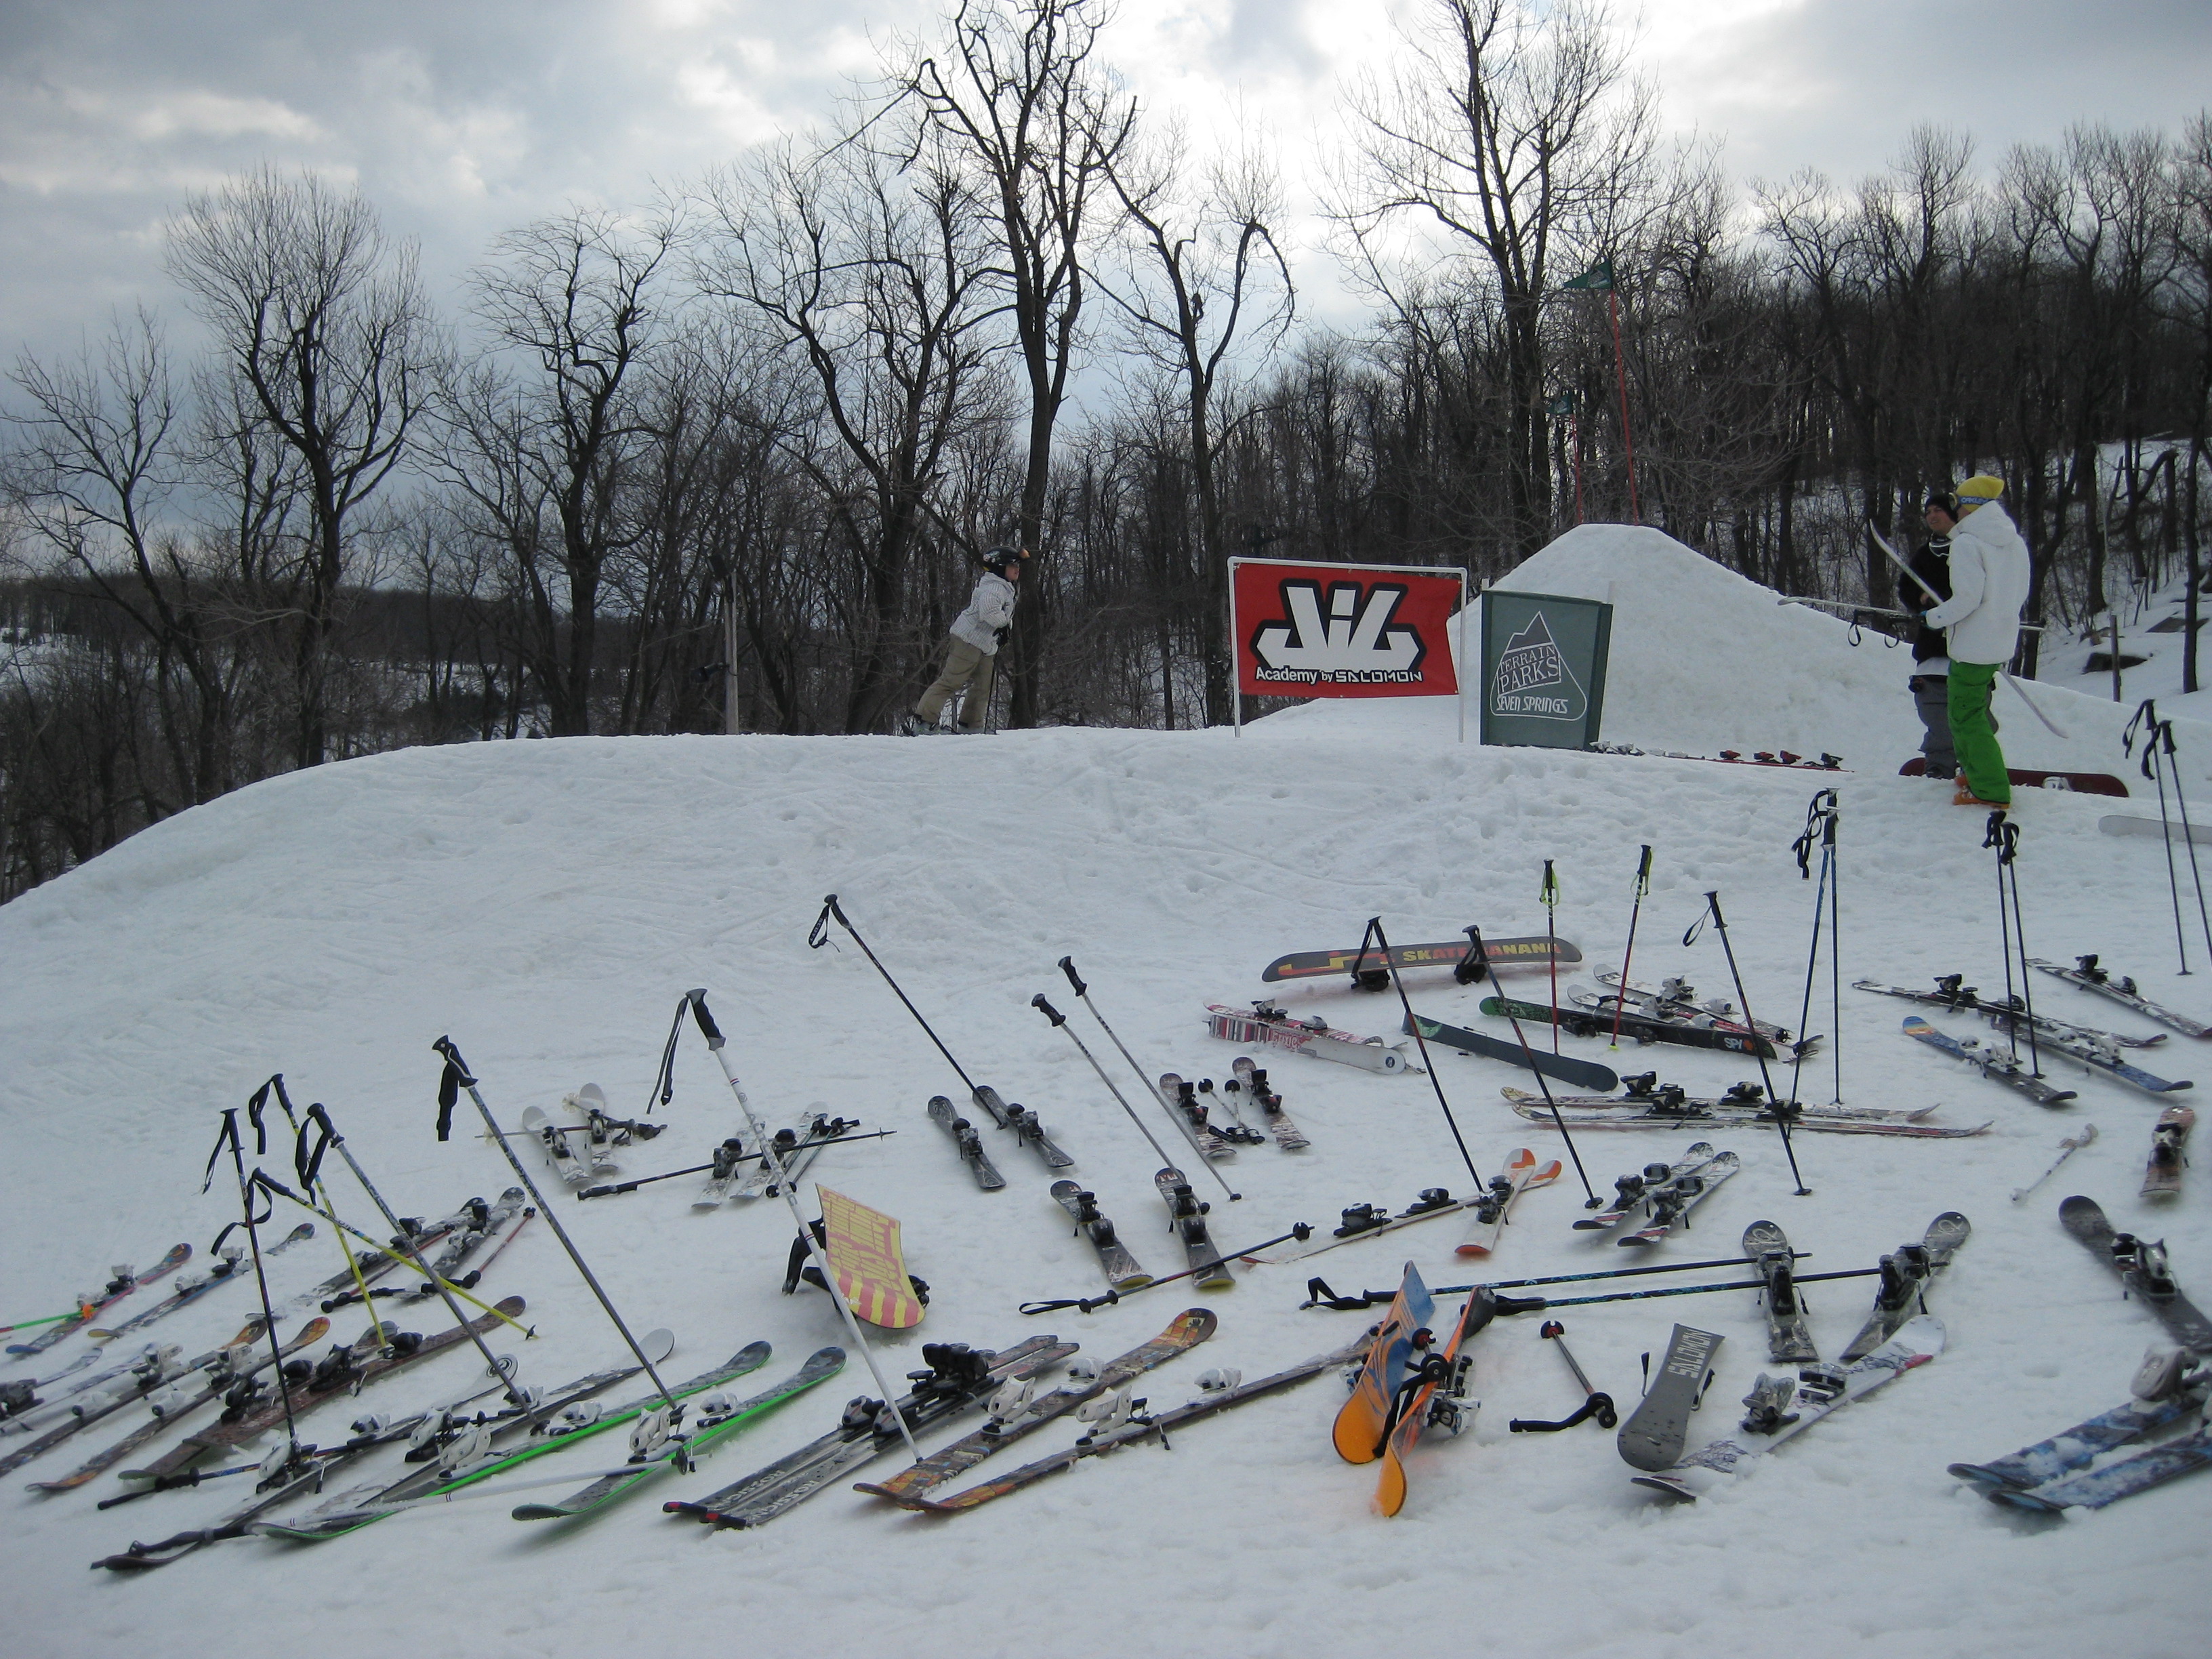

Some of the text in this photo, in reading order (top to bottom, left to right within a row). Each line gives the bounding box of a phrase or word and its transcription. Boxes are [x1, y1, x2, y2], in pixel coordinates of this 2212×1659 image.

[1499, 645, 1556, 676] TERRAIN
[1256, 666, 1423, 685] Academy by SALOMON
[1500, 655, 1559, 693] PARKS
[1496, 695, 1569, 714] SEVEN SPRINGS
[1402, 947, 1468, 962] SKATE
[1723, 1037, 1743, 1050] SPY
[1667, 1328, 1713, 1378] SALOMON
